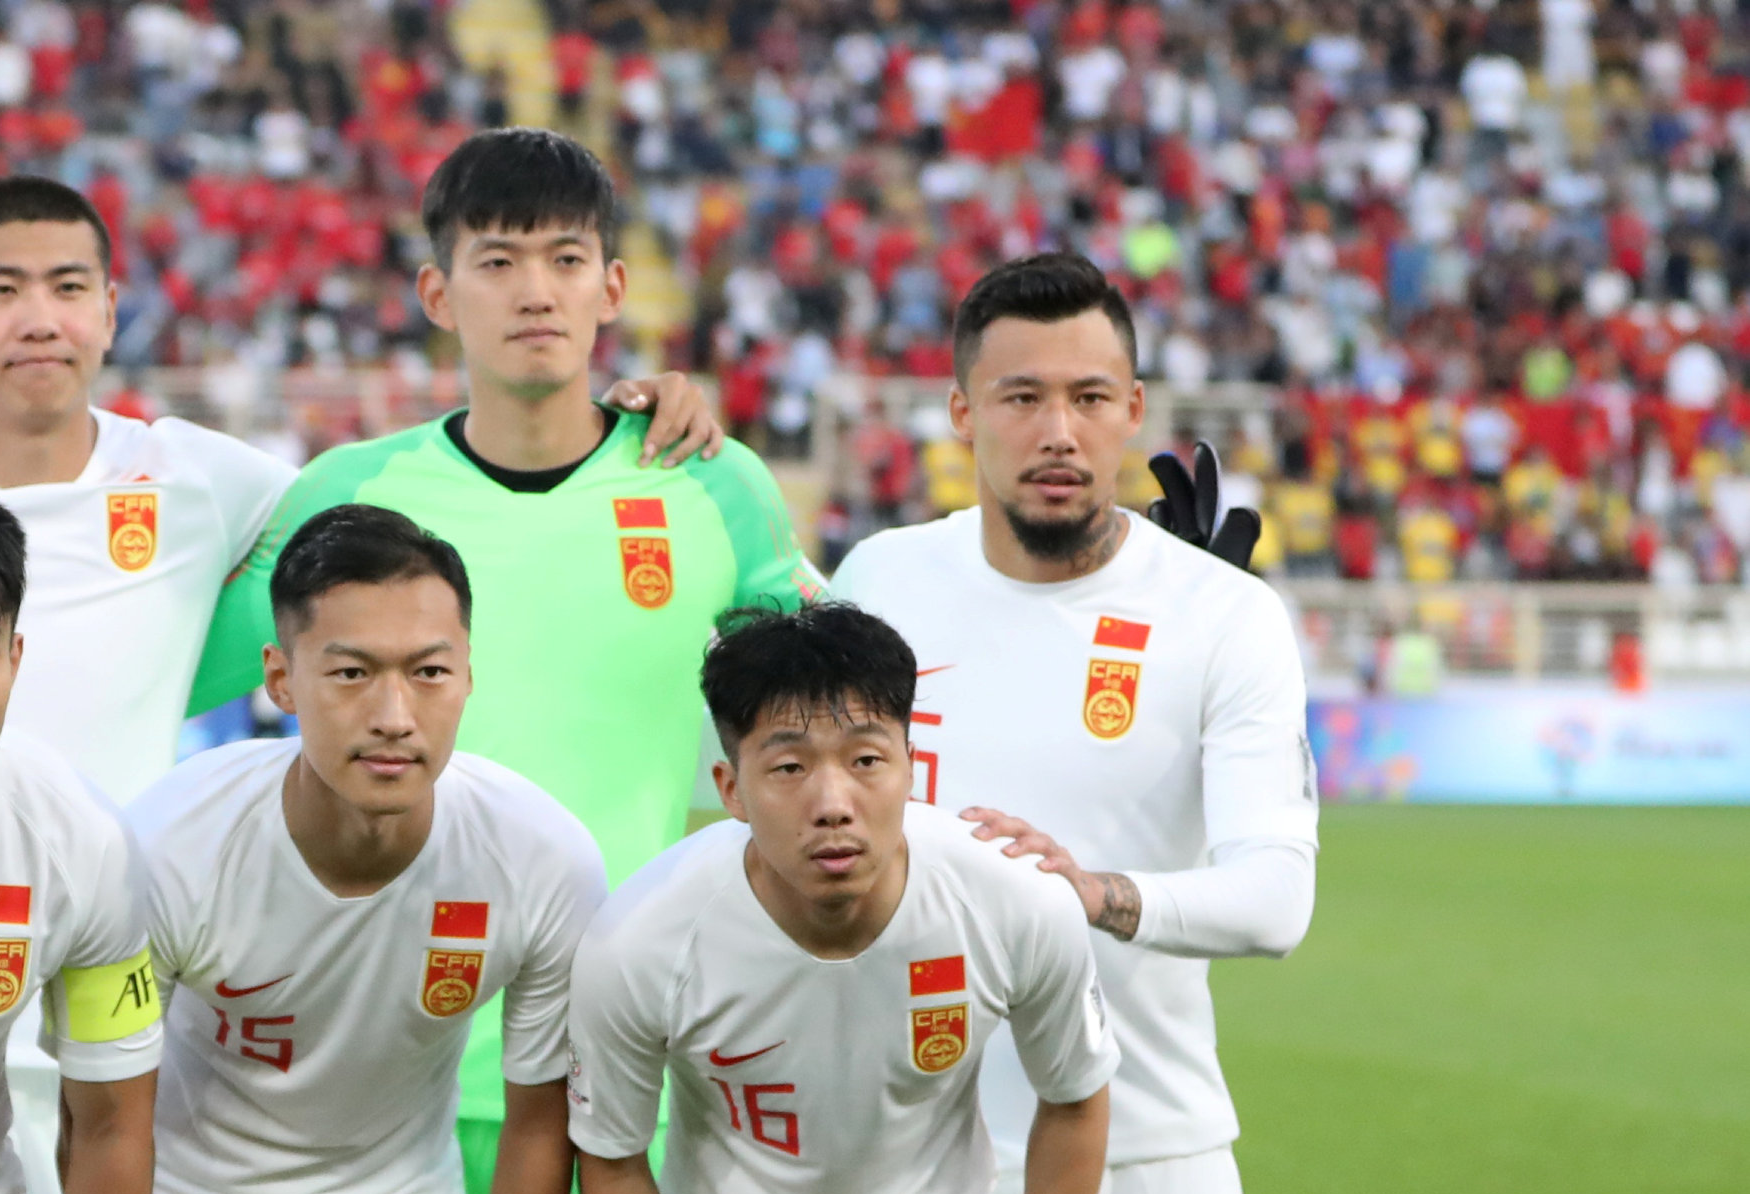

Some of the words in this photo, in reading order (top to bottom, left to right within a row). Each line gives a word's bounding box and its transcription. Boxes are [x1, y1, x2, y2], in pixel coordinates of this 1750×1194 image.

[1091, 661, 1138, 682] CFA
[431, 954, 480, 968] CFA
[915, 1008, 963, 1027] CFA
[211, 1006, 295, 1073] 15
[709, 1076, 799, 1156] 16
